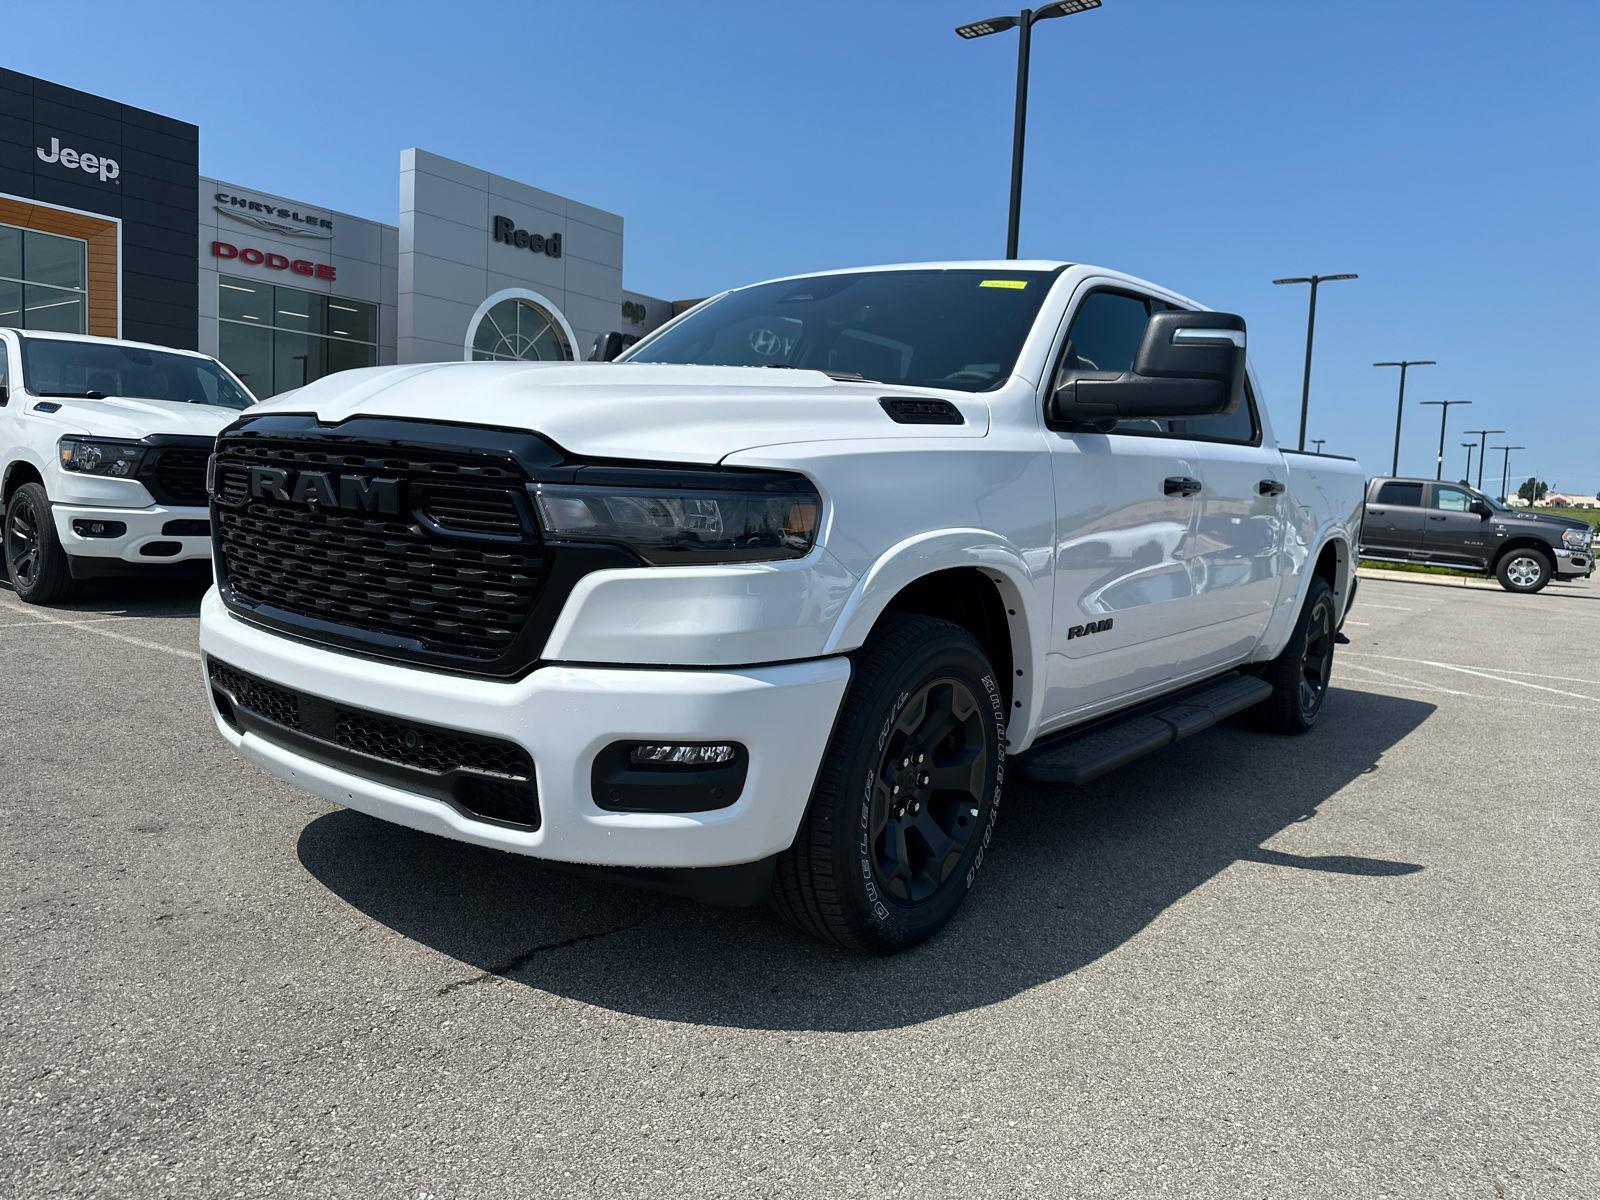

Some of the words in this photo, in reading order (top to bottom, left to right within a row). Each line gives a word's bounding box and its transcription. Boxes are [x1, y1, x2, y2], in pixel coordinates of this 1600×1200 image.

[36, 137, 120, 182] Jeep
[214, 193, 334, 230] CHRYSLER
[493, 214, 562, 259] Reed
[212, 241, 337, 281] DODGE
[249, 465, 402, 515] RAM
[1067, 618, 1114, 641] RAM
